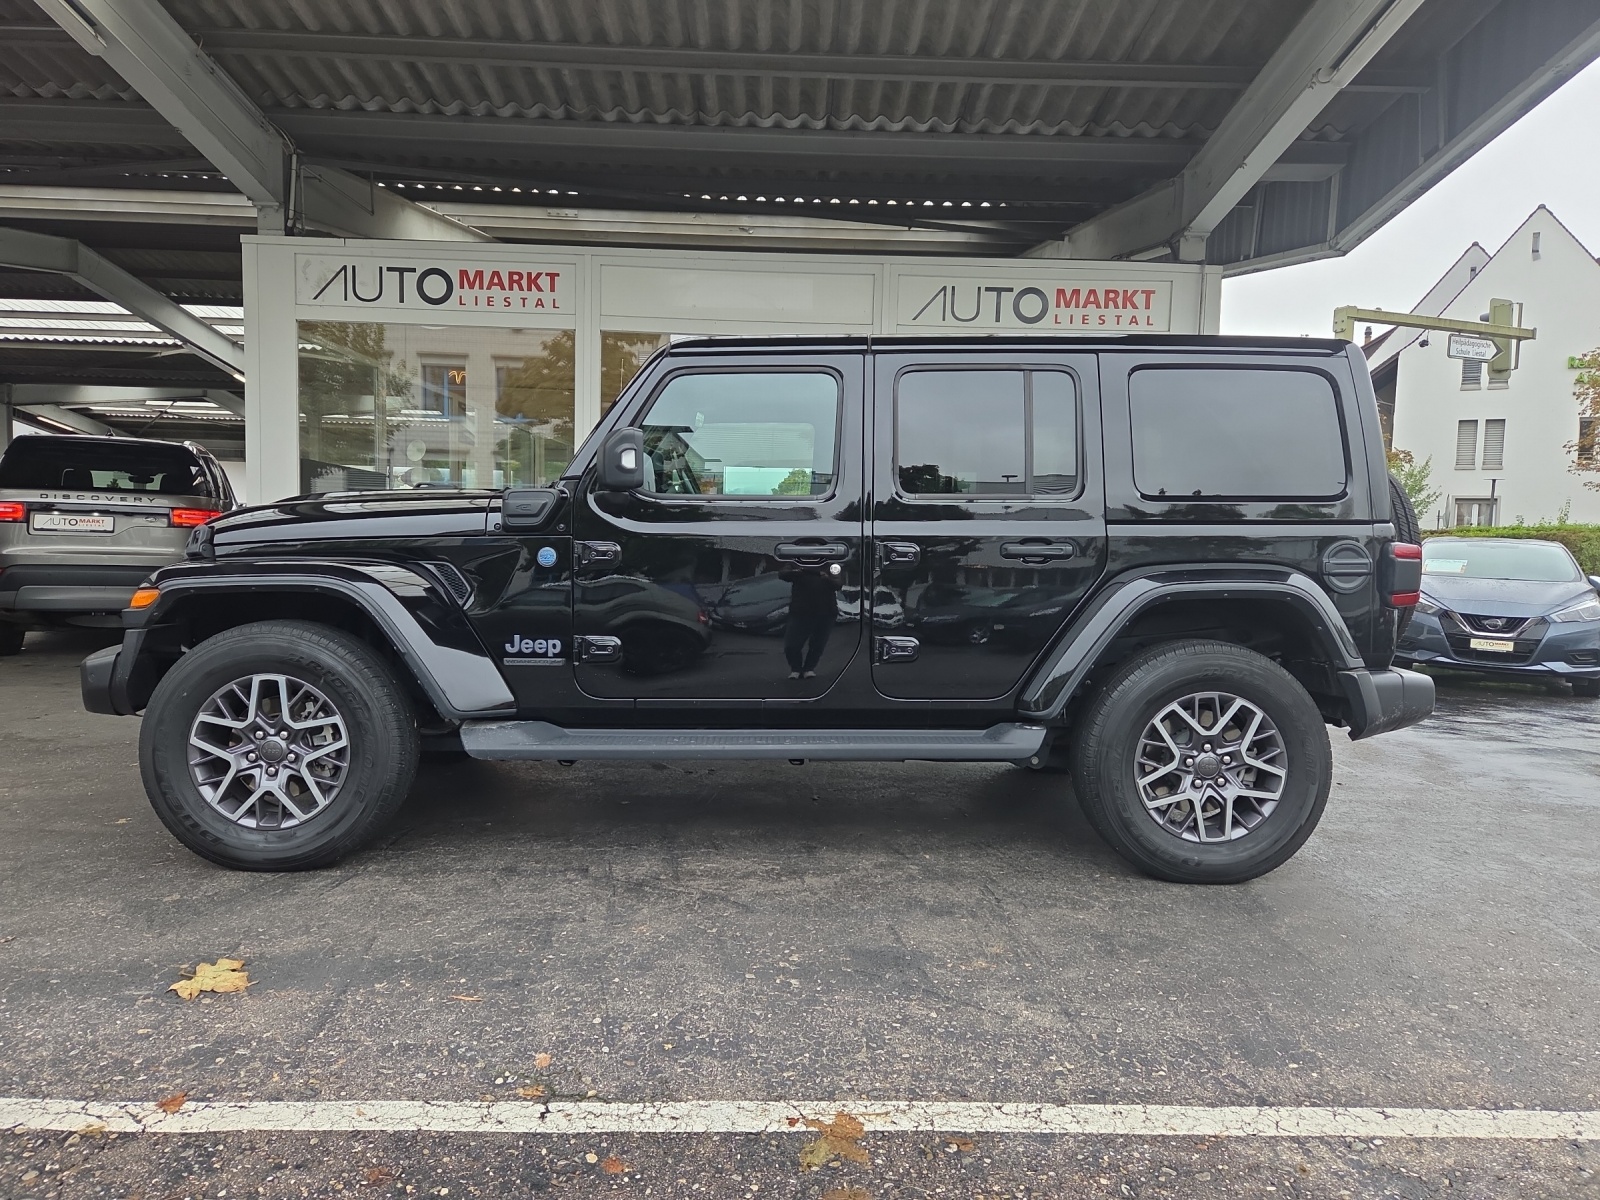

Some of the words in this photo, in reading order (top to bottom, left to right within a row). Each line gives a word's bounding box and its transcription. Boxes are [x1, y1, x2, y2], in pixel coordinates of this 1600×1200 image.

[312, 264, 454, 306] AUTO
[458, 269, 561, 293] MARKT
[458, 295, 560, 309] LIESTAL
[912, 285, 1050, 325] AUTO
[1055, 288, 1156, 310] MARKT
[1054, 314, 1154, 326] LIESTAL
[1452, 337, 1491, 349] Heilpädagogische
[1455, 347, 1471, 356] Schule
[1472, 349, 1487, 357] Liestal
[40, 493, 156, 504] DISCOVERY
[42, 518, 78, 526] AUTO
[505, 634, 562, 657] Jeep
